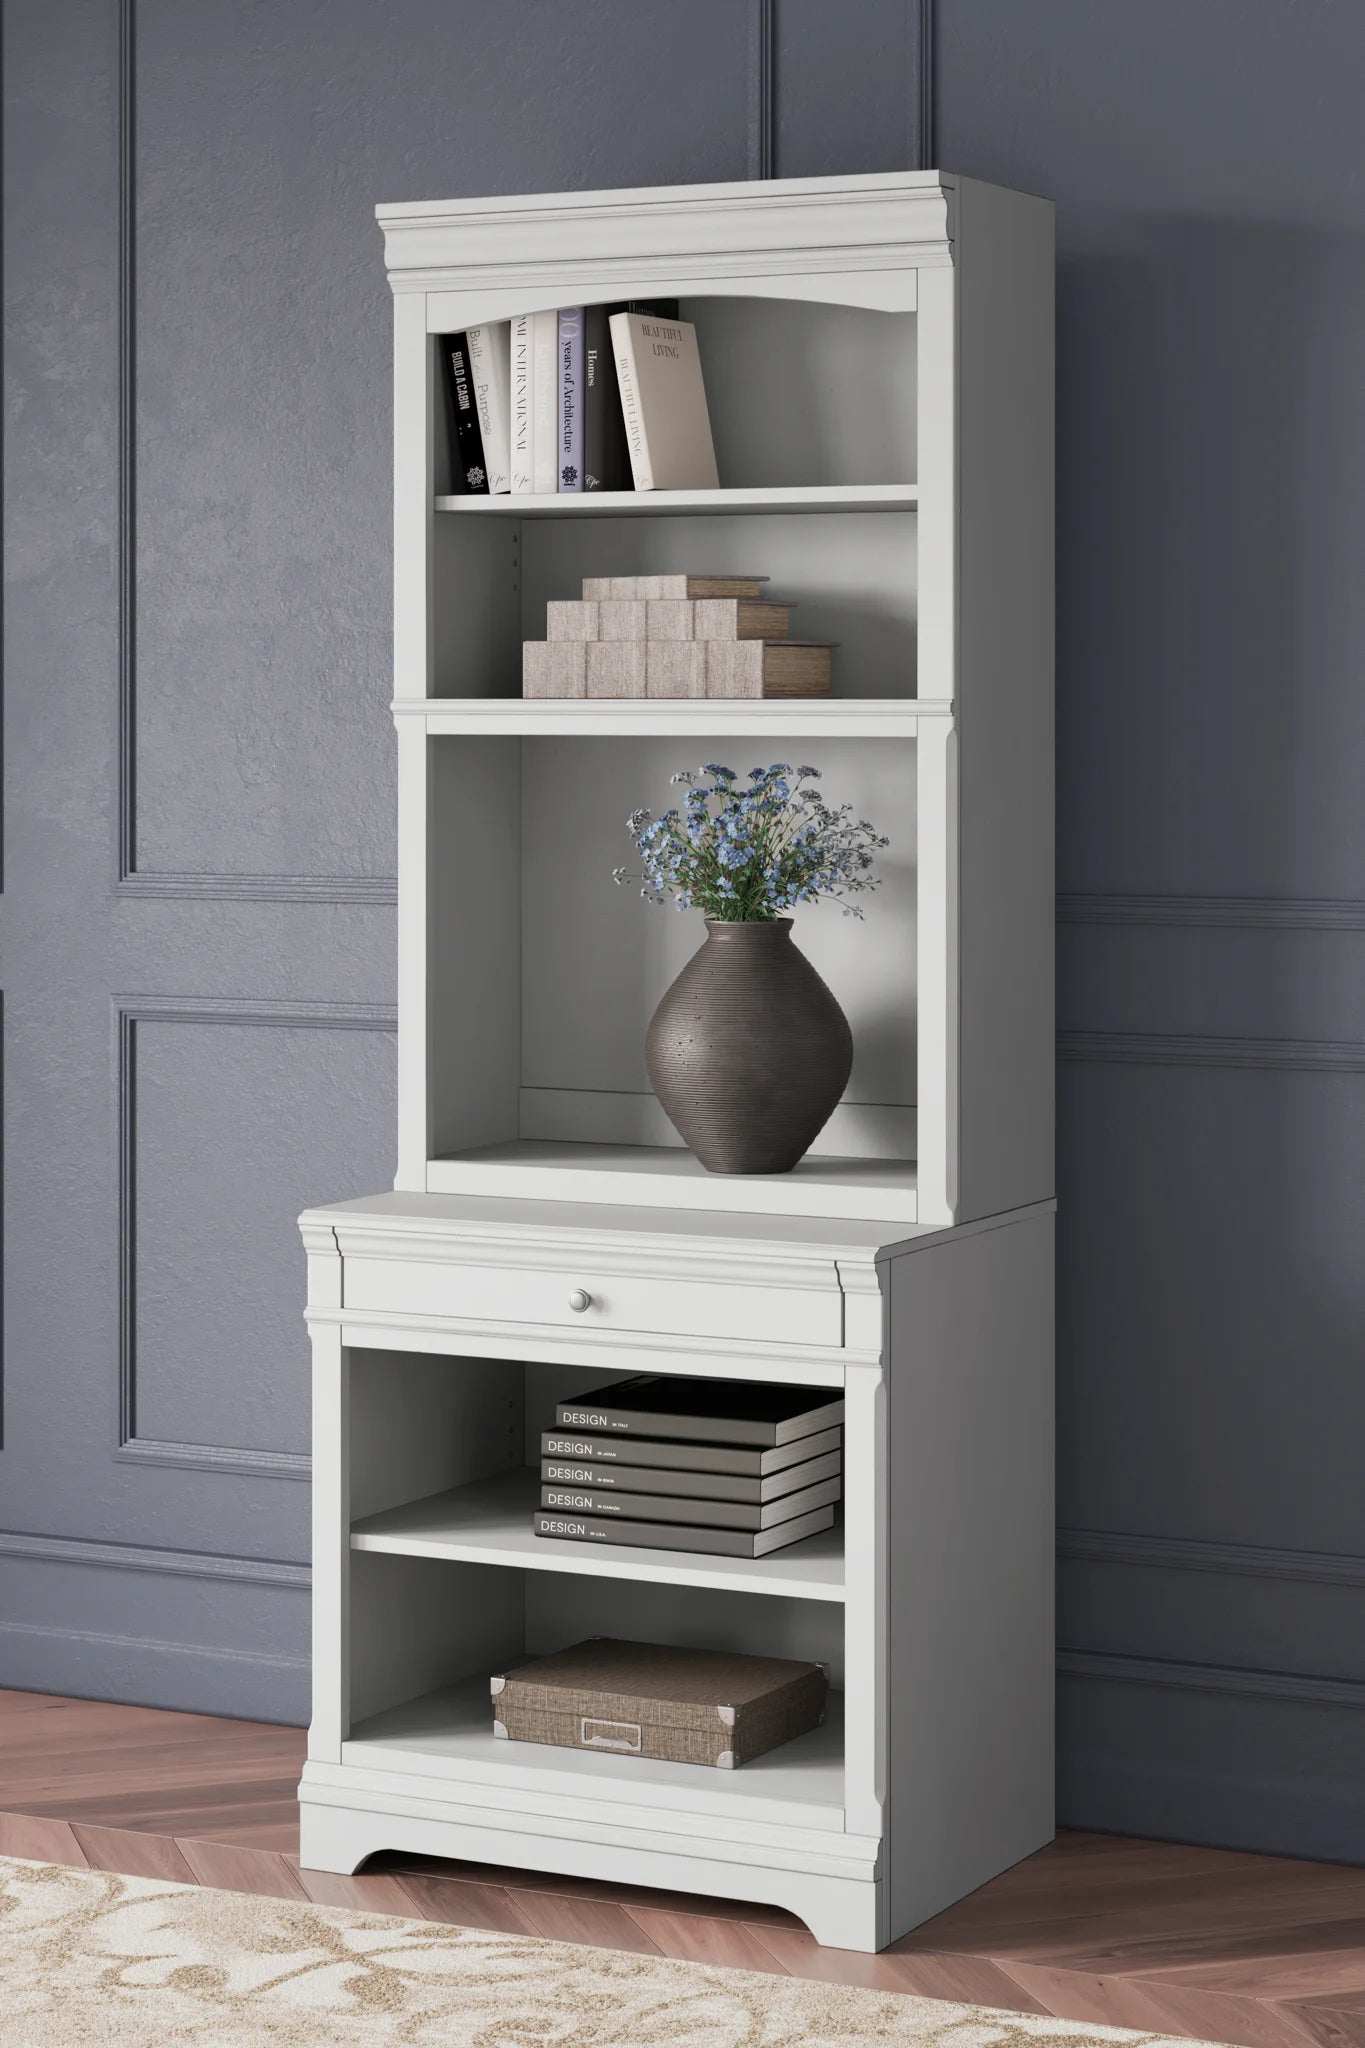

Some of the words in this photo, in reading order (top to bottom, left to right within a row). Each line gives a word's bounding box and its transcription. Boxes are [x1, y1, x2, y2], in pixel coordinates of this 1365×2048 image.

[641, 323, 684, 342] BEAUTIFUL
[562, 341, 572, 370] years
[652, 343, 679, 359] LIVING
[452, 351, 465, 376] BUILD
[588, 350, 598, 387] Homes
[470, 328, 483, 358] Built
[478, 383, 491, 436] Purpose
[564, 373, 575, 385] of
[457, 384, 470, 410] CABIN
[517, 344, 527, 453] INTERNATIONAL
[564, 386, 575, 453] Architecture
[563, 1412, 607, 1426] DESIGN
[548, 1440, 592, 1455] DESIGN
[548, 1467, 592, 1481] DESIGN
[548, 1493, 592, 1508] DESIGN
[541, 1520, 585, 1535] DESIGN
